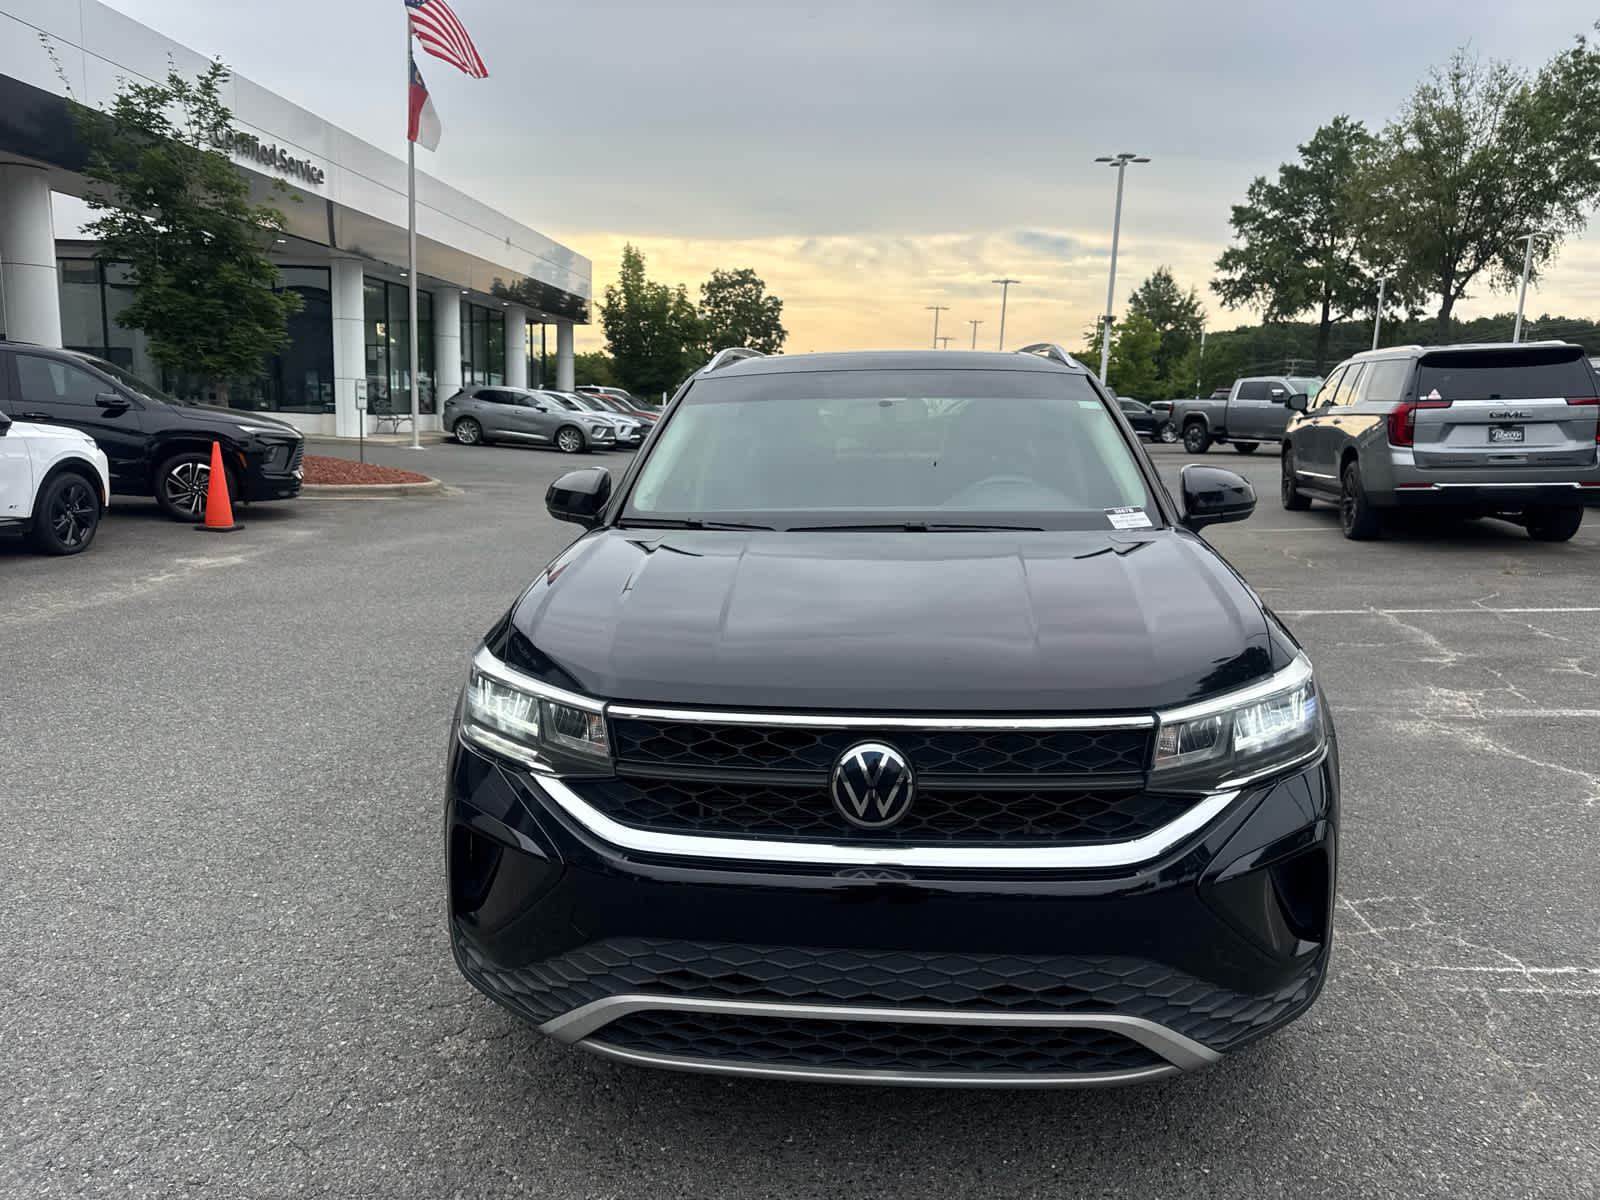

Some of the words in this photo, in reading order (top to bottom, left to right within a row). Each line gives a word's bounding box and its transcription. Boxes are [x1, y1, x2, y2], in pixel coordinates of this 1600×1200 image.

[279, 148, 325, 185] Service
[1488, 409, 1533, 419] GMC
[837, 746, 908, 821] VW
